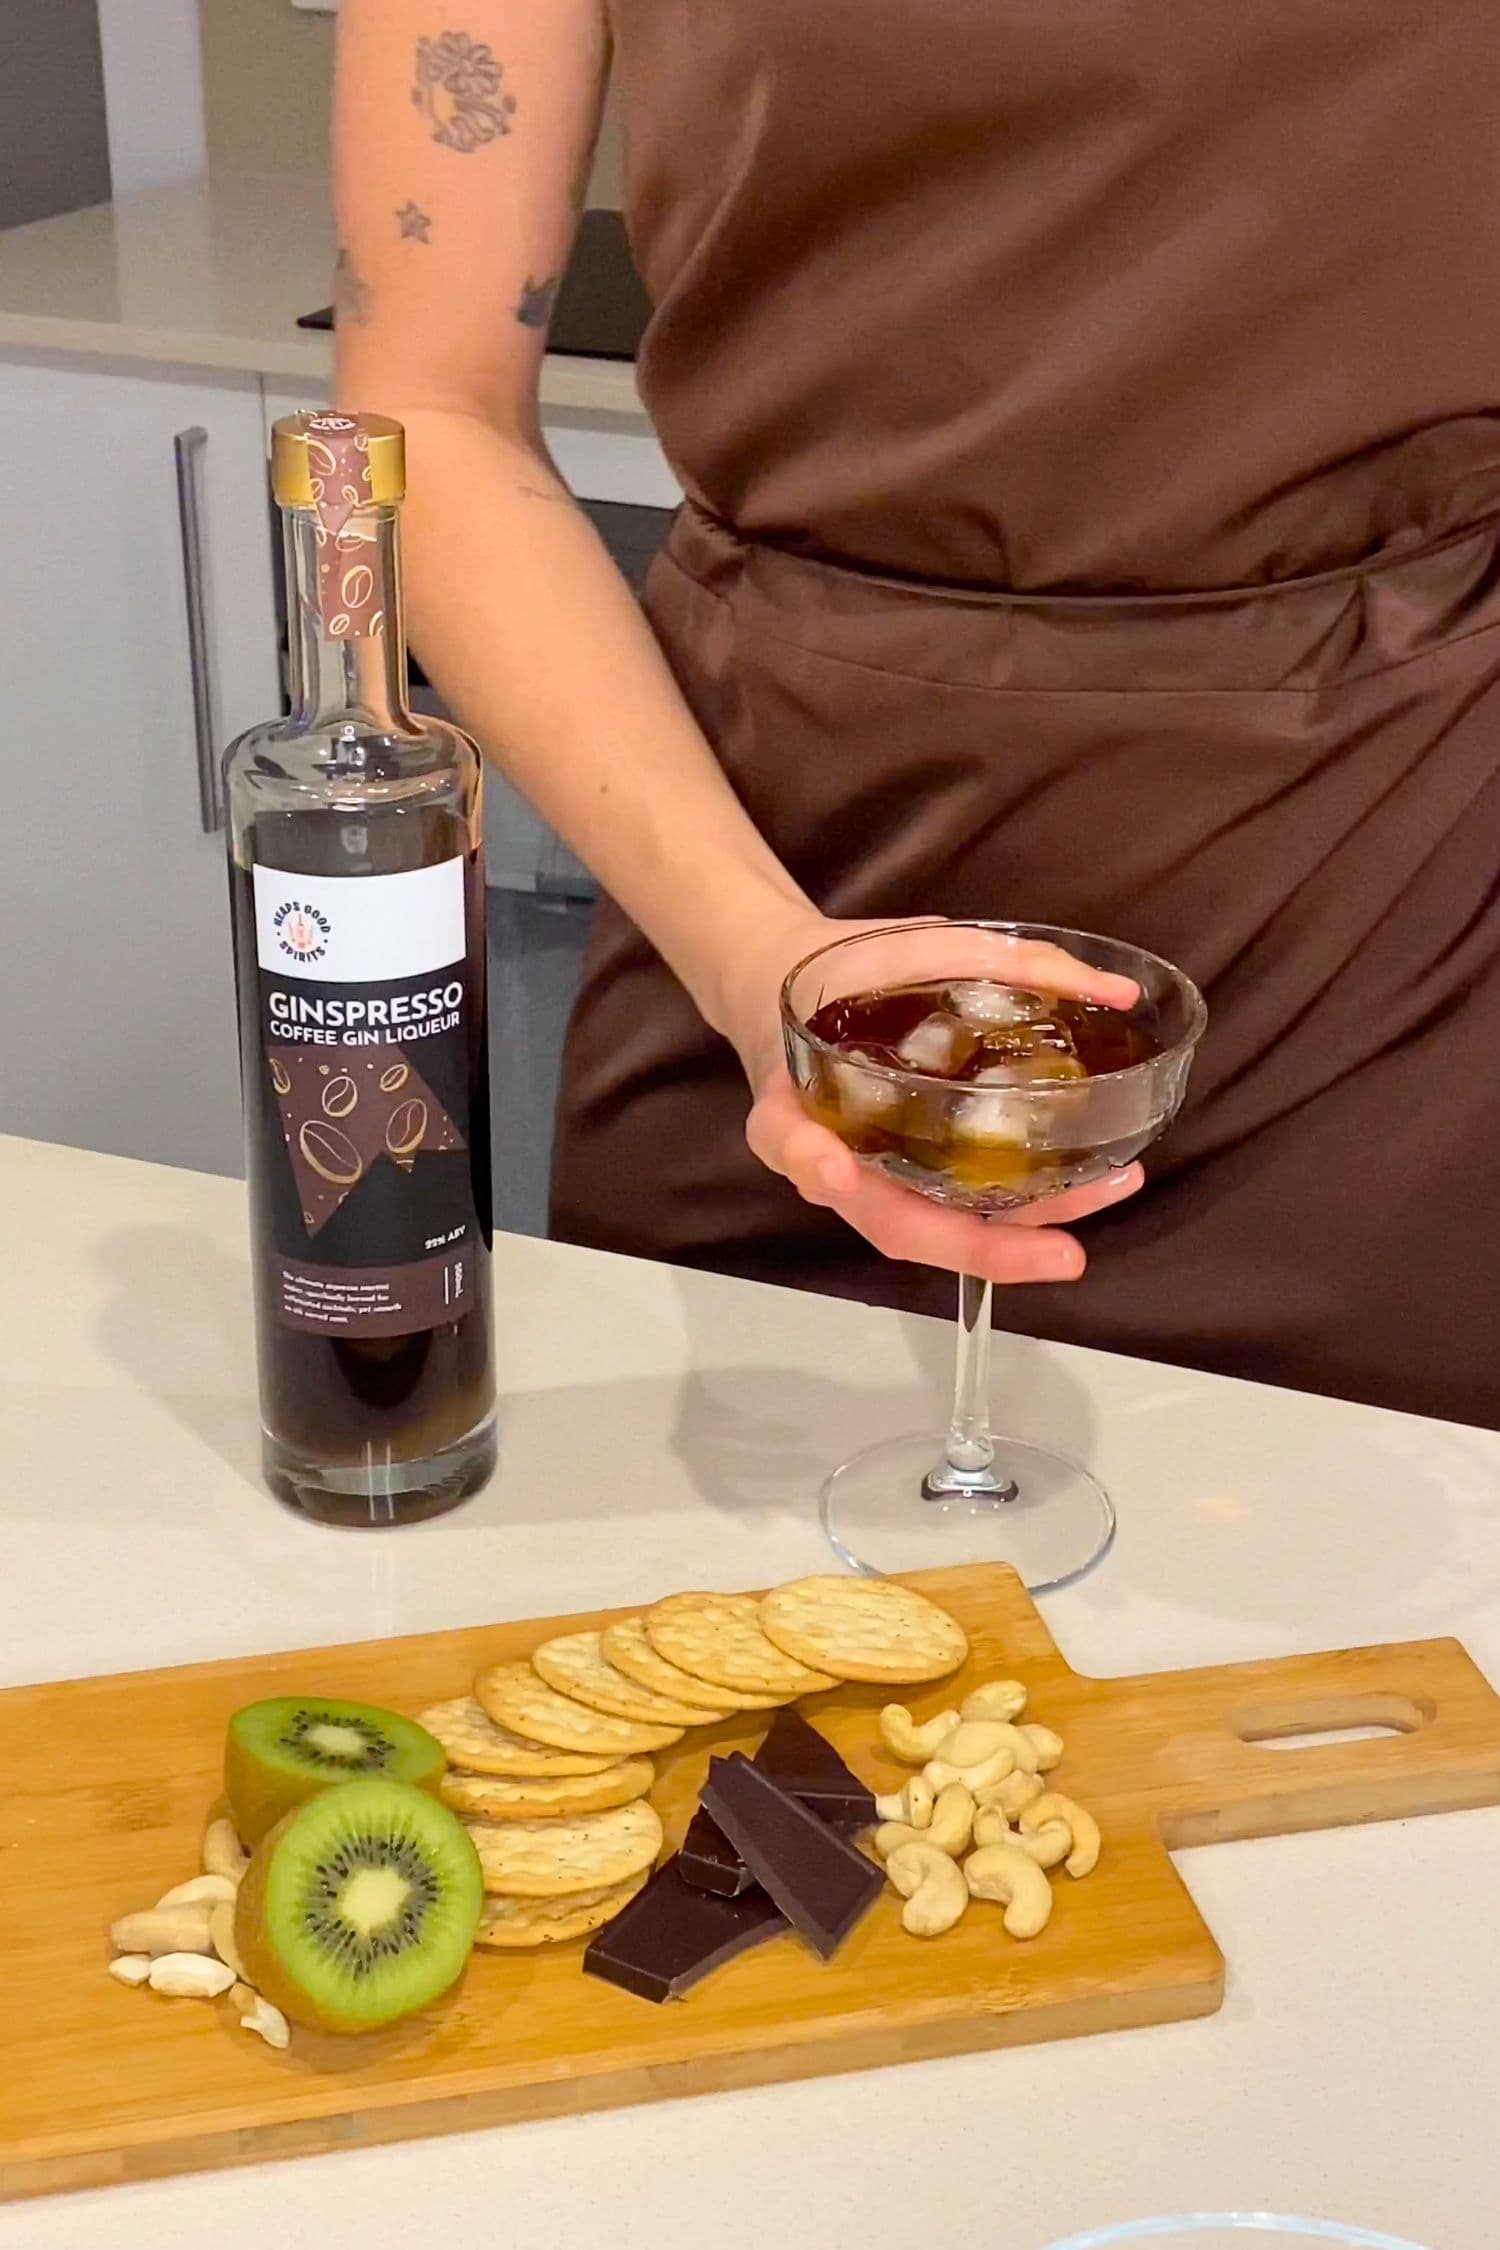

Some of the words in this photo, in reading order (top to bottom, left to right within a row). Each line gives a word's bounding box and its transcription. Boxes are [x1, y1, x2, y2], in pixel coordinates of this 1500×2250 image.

[279, 940, 326, 963] SPIRITS
[269, 981, 463, 1027] GINSPRESSO
[270, 1020, 338, 1046] COFFEE
[342, 1030, 380, 1046] GIN
[385, 1011, 460, 1044] LIQUEUR
[447, 1224, 466, 1241] ABV
